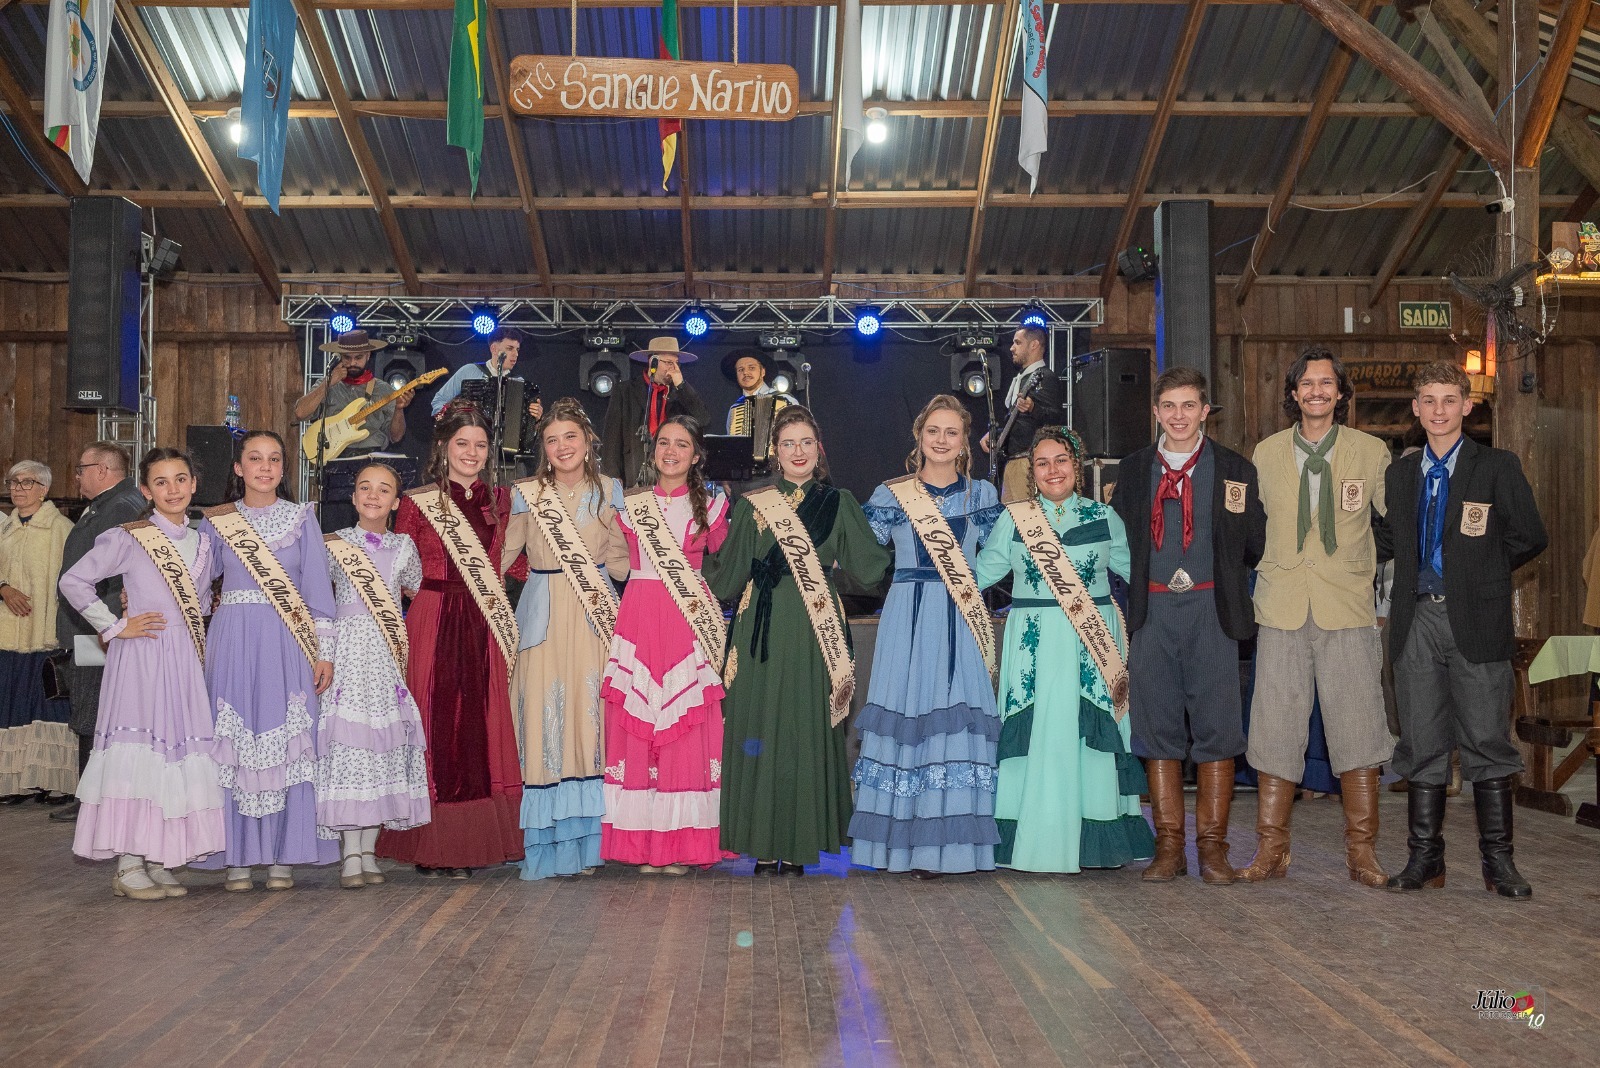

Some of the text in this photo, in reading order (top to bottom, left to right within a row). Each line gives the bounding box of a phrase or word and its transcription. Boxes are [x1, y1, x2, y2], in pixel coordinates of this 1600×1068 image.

[512, 62, 792, 114] CTG Sangue Nativo
[1402, 304, 1449, 326] SAÍDA
[234, 539, 270, 578] Prenda
[264, 578, 292, 613] Mirim
[434, 512, 472, 556] Prenda
[460, 556, 495, 597] Juvenil
[538, 509, 574, 552] Prenda
[561, 552, 599, 593] Juvenil
[636, 515, 671, 558] Prenda
[659, 558, 697, 599] Juvenil
[780, 535, 820, 593] Prenda
[924, 530, 967, 587] Prenda
[1029, 540, 1072, 597] Prenda
[161, 561, 191, 605] Prenda
[350, 568, 384, 608] Prenda
[376, 609, 401, 645] Mirim
[708, 624, 721, 649] Região
[817, 623, 838, 671] Tradicionalista
[829, 632, 842, 659] Região
[1080, 622, 1108, 667] Tradicionalista
[1094, 628, 1110, 653] Região
